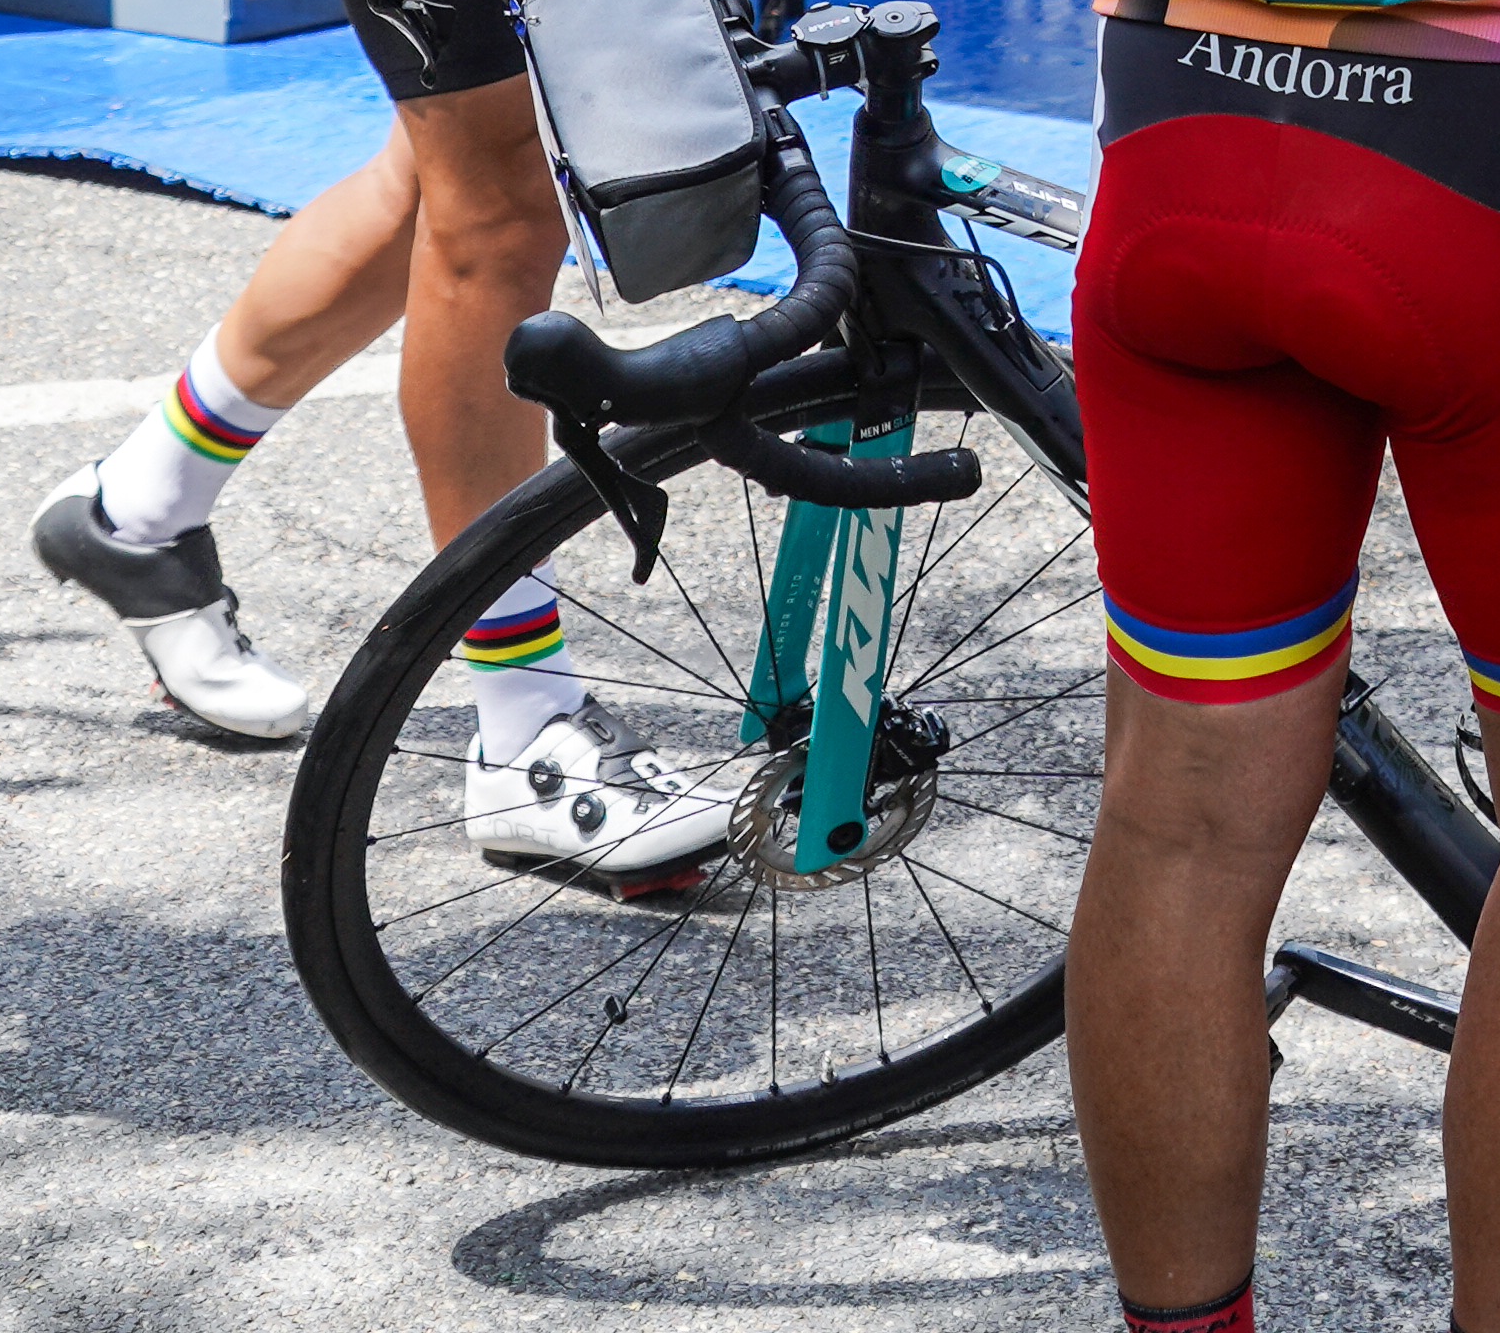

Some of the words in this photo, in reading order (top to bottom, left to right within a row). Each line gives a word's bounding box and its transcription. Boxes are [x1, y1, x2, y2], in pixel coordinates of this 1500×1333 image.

[1178, 32, 1413, 104] Andorra
[860, 426, 880, 440] MEN
[881, 421, 892, 434] IN
